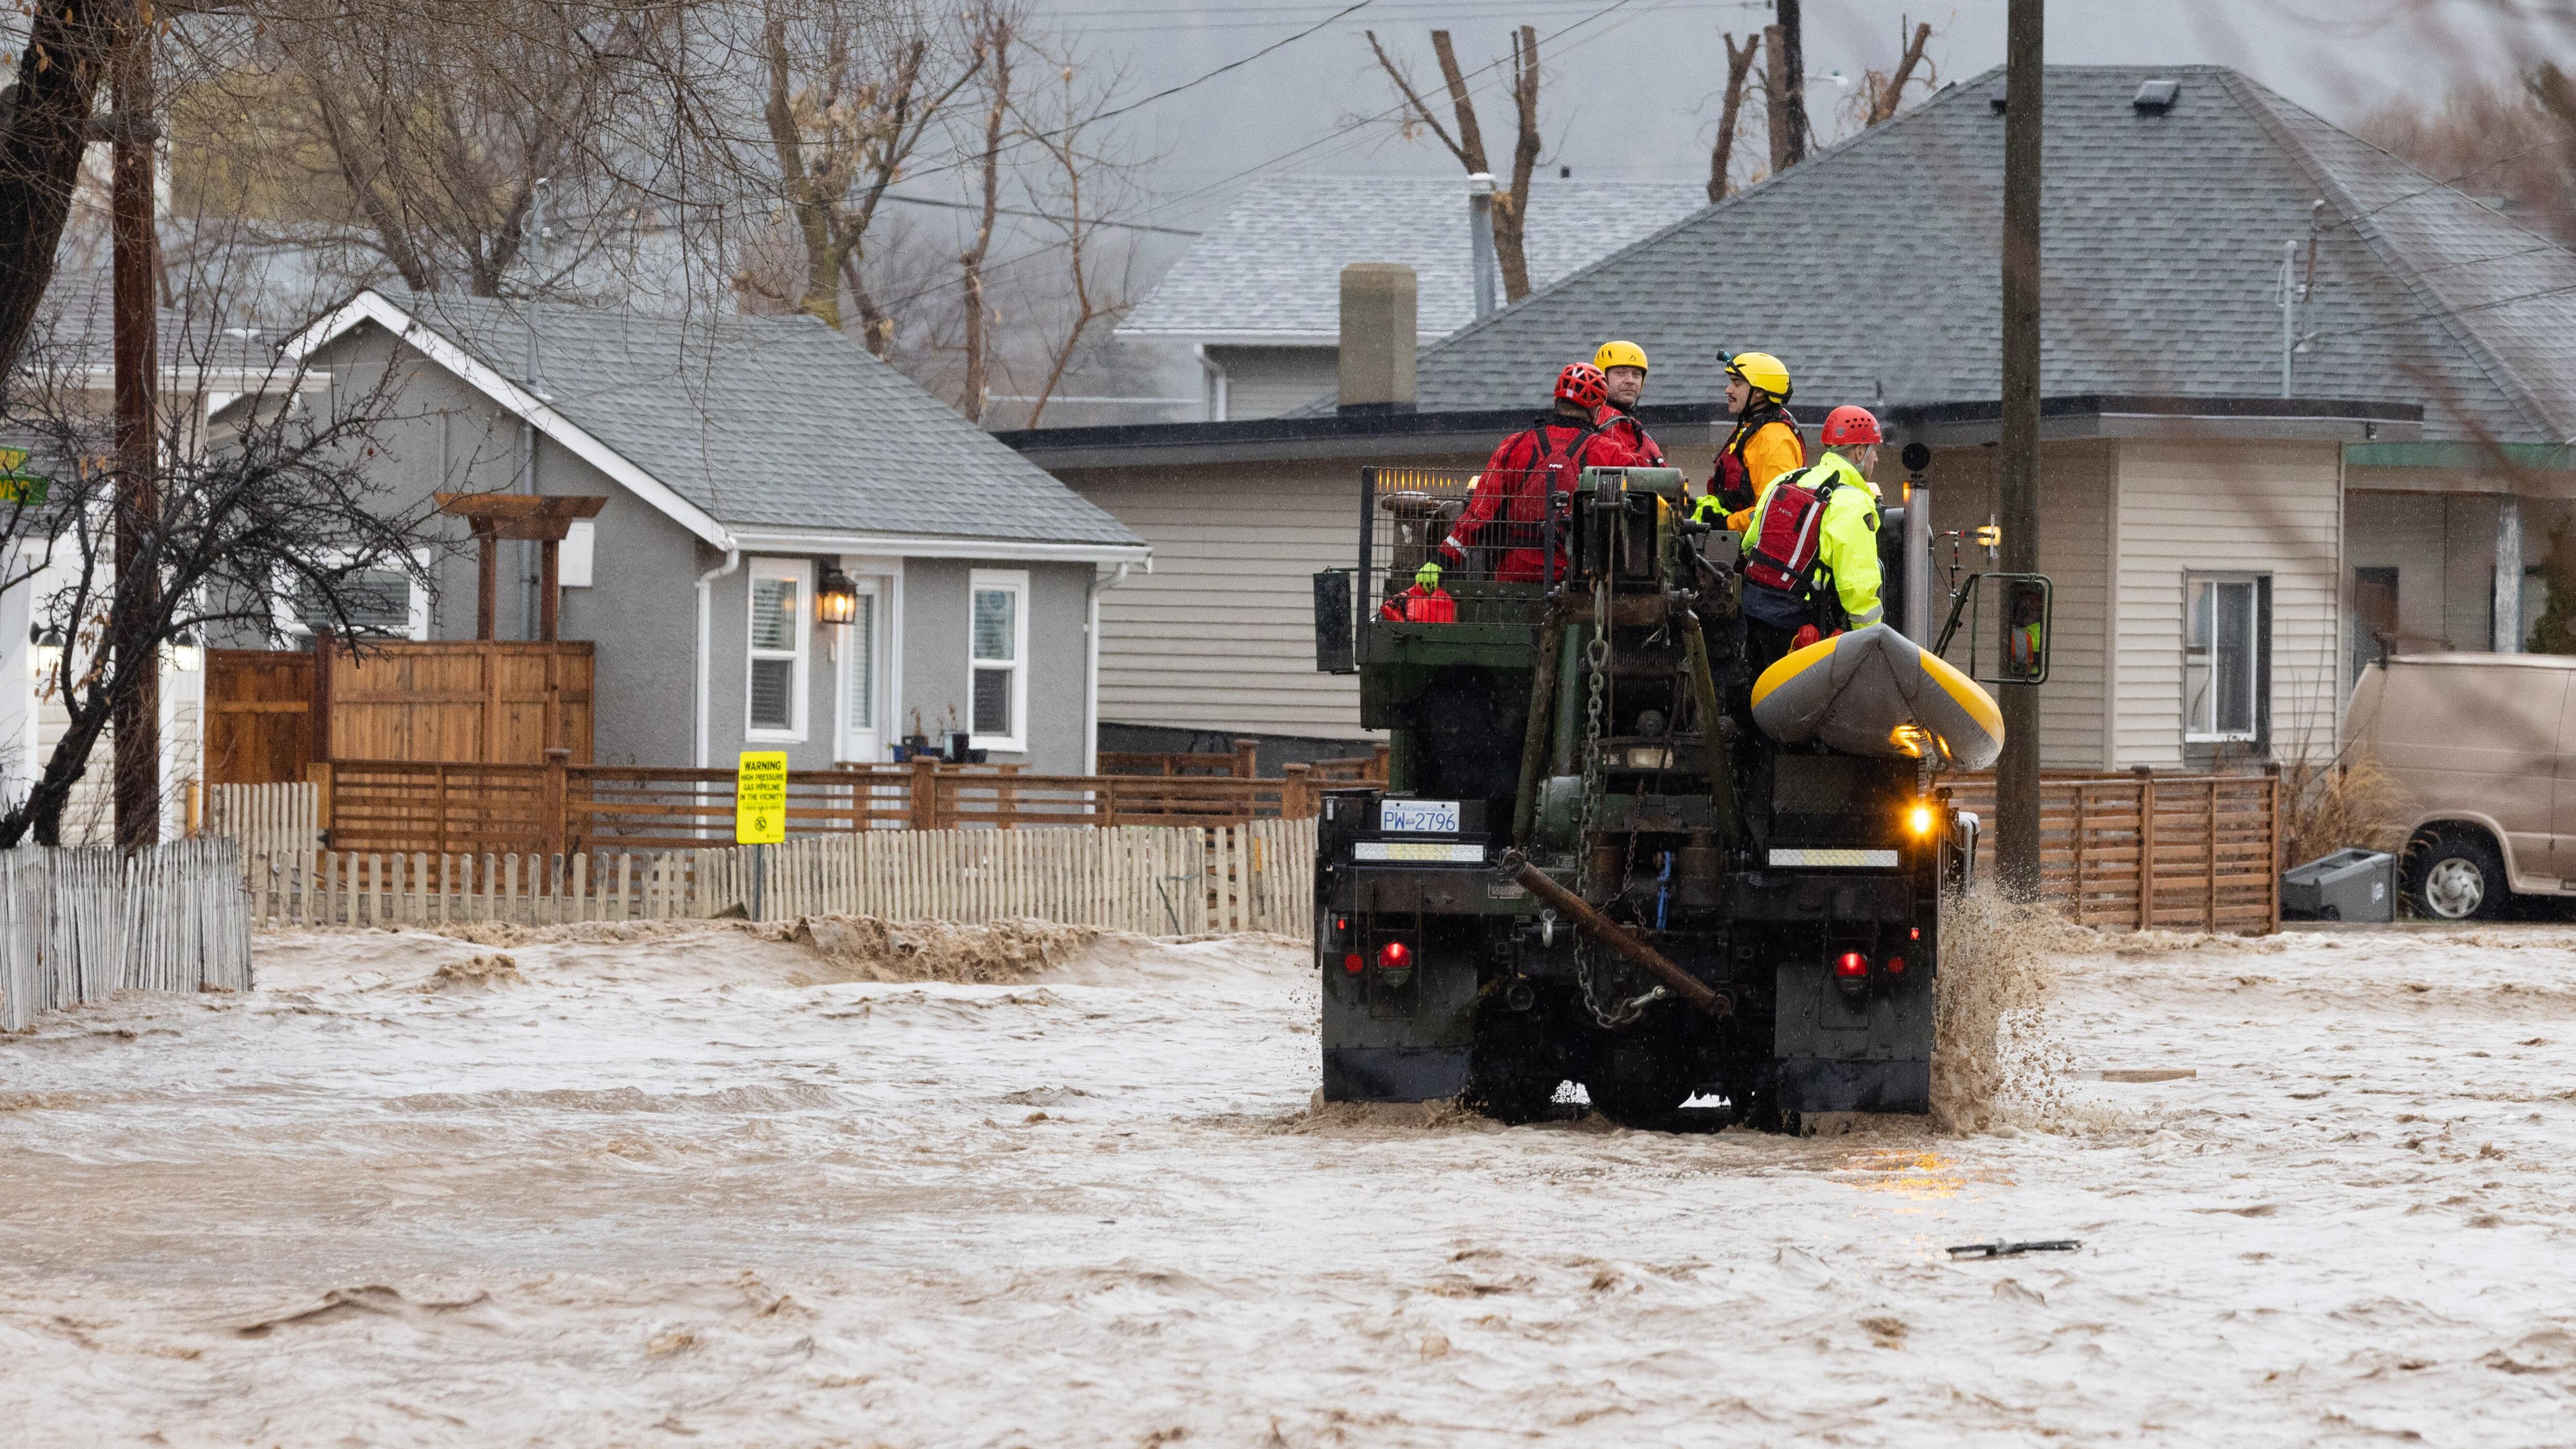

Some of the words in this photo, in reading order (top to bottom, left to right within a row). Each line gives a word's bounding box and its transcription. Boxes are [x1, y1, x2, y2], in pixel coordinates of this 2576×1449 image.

[744, 761, 781, 771] WARNING
[1384, 811, 1405, 829] PW
[1415, 812, 1455, 830] 2796
